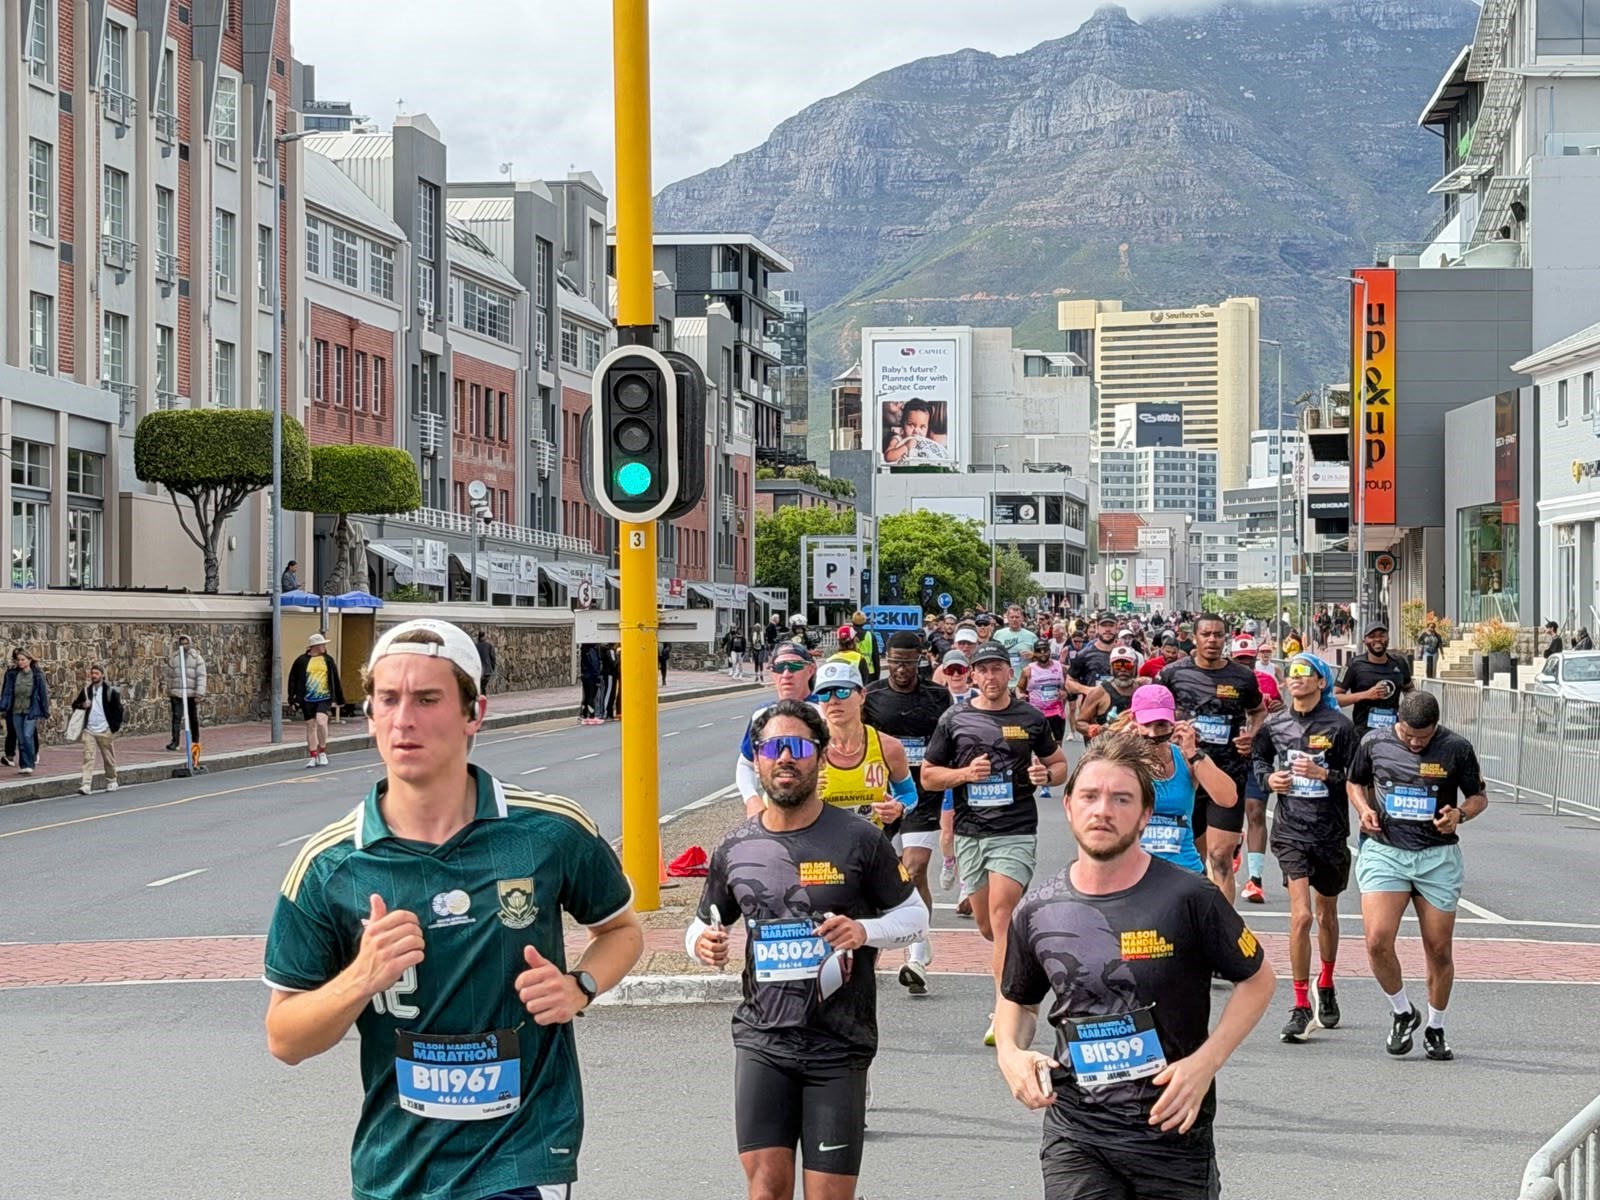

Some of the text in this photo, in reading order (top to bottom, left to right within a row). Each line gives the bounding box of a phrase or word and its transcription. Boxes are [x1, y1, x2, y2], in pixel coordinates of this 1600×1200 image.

[882, 366, 907, 374] Baby's
[882, 383, 911, 391] Capitec
[1157, 413, 1180, 422] stitch
[1358, 480, 1392, 490] roup
[634, 533, 641, 546] 3
[826, 562, 838, 578] P
[924, 577, 934, 586] 23
[866, 764, 883, 787] 40
[972, 785, 1007, 796] D13985
[1394, 796, 1427, 809] D13311
[800, 861, 831, 869] NELSON
[800, 866, 838, 875] MANDELA
[800, 873, 845, 882] MARATHON
[1121, 930, 1157, 939] NELSON
[1121, 936, 1166, 947] MANDELA
[757, 939, 825, 961] D43024
[1121, 943, 1174, 955] MARATHON
[1078, 1024, 1137, 1039] MARATHON
[413, 1041, 487, 1050] NELSON MANDELA
[1080, 1037, 1144, 1064] B11399
[413, 1047, 498, 1062] MARATHON
[412, 1065, 502, 1093] B11967
[438, 1095, 476, 1104] 466/64
